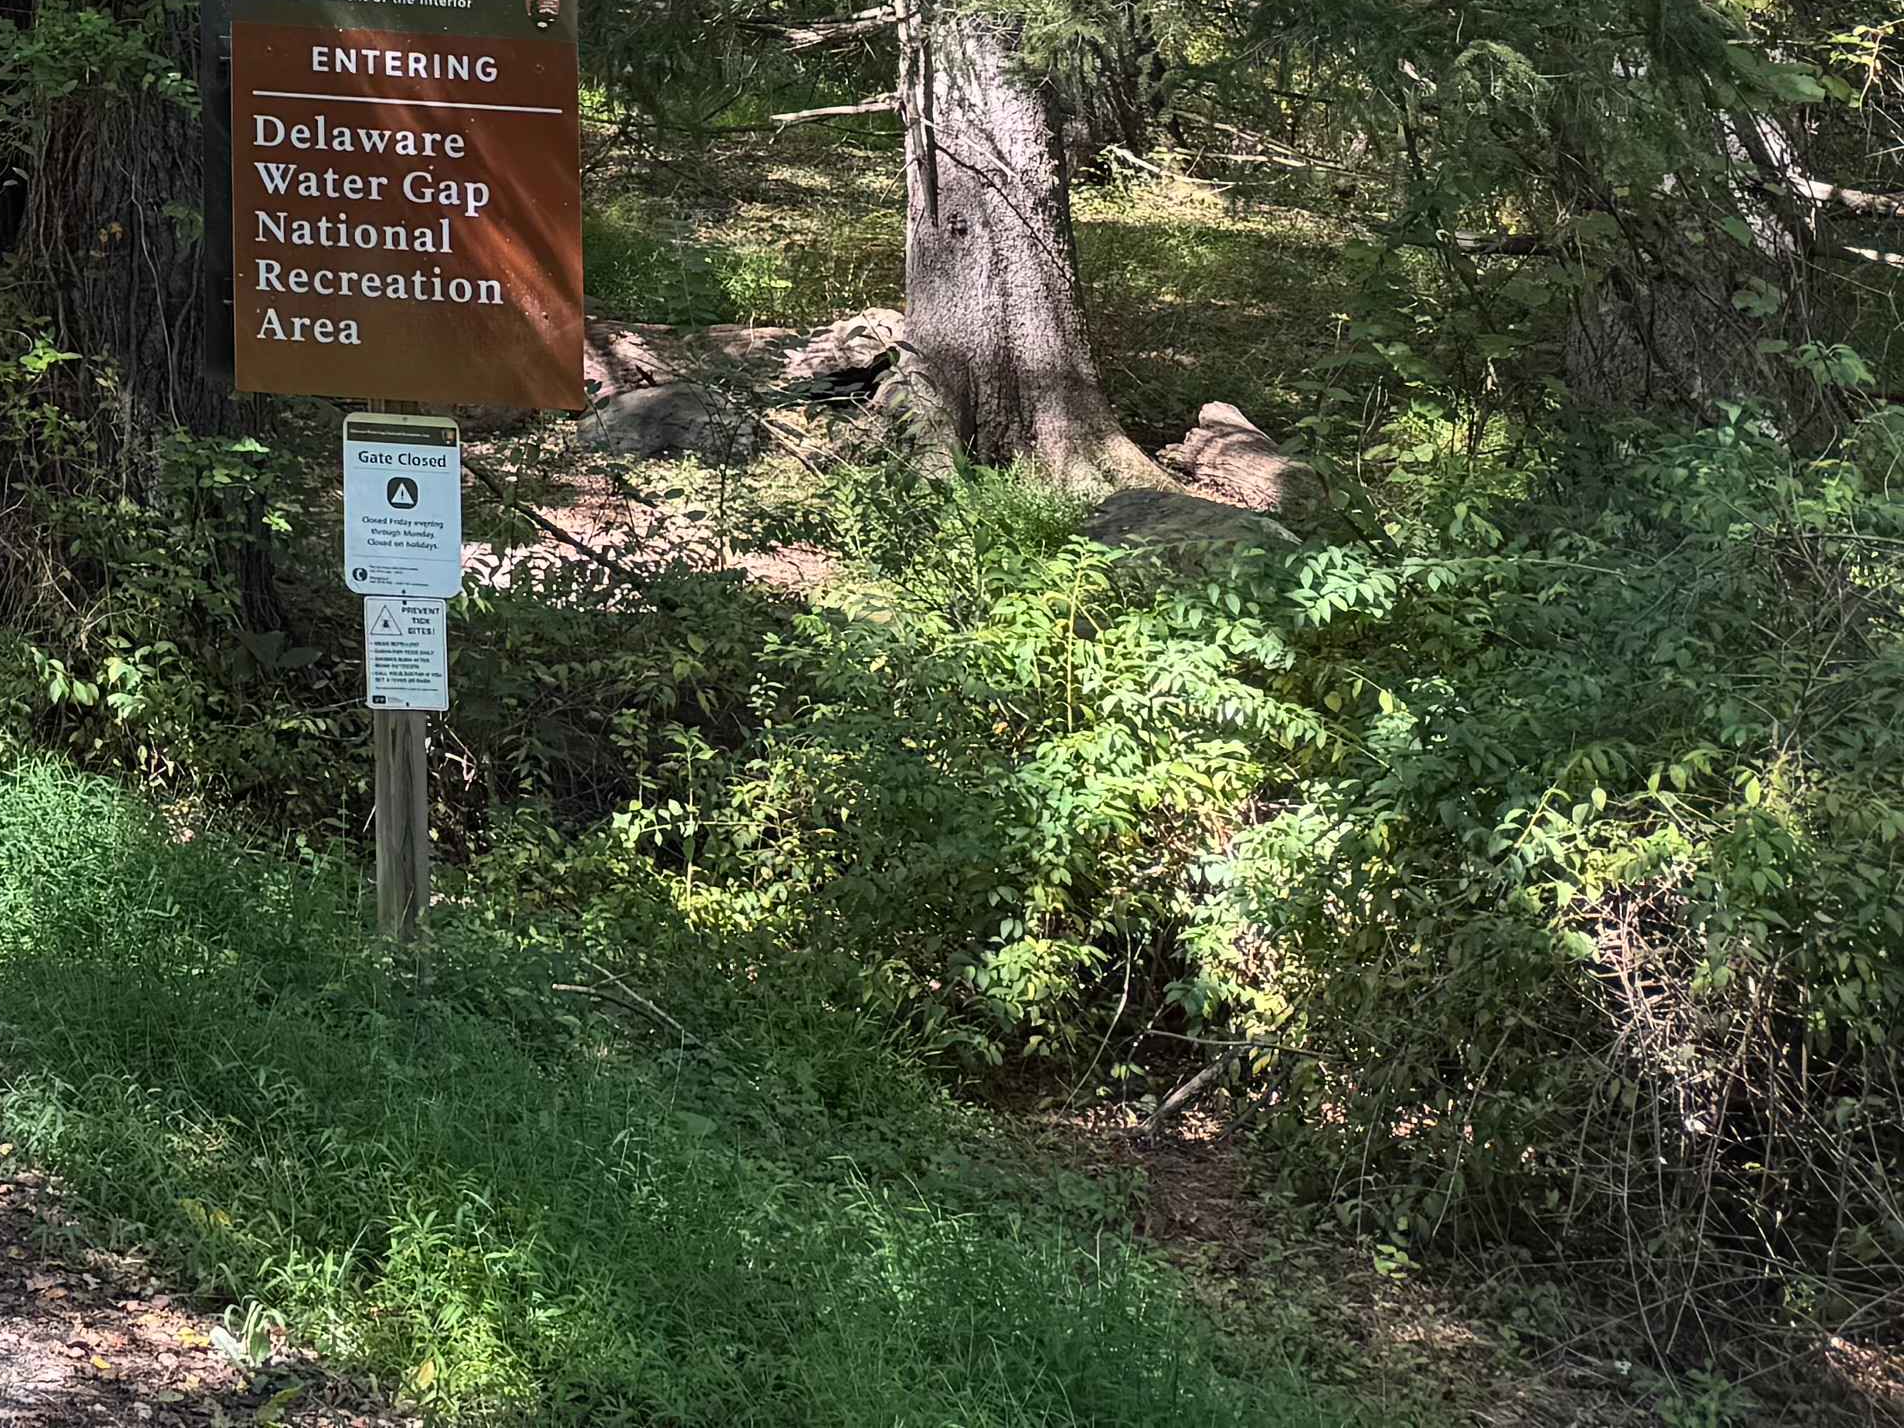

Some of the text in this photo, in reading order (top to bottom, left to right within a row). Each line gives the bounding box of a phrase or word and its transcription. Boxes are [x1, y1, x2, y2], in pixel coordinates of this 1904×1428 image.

[312, 46, 498, 82] ENTERING
[253, 115, 465, 159] Delaware
[254, 162, 490, 217] Water Gap
[255, 210, 452, 254] National
[255, 259, 504, 305] Recreation
[257, 308, 361, 345] Area
[358, 450, 446, 467] Gate Closed
